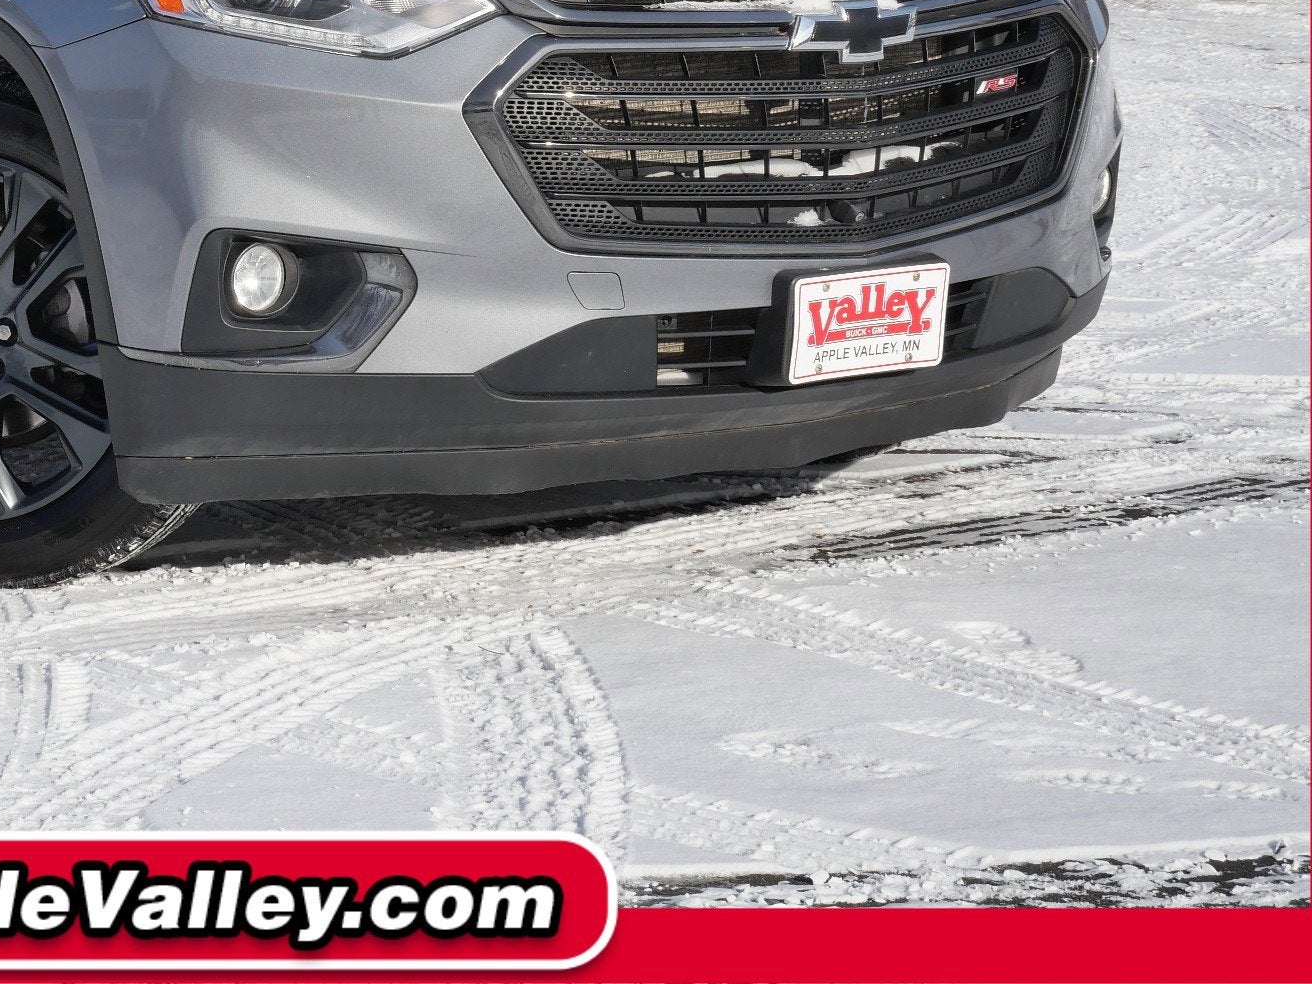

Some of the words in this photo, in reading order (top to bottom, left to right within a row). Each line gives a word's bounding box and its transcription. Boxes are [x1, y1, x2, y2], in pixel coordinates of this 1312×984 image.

[979, 74, 1018, 94] RS
[808, 282, 937, 347] Valley
[845, 327, 867, 338] BUICK
[871, 325, 888, 335] GMC
[813, 347, 850, 364] APPLE
[853, 342, 899, 358] VALLEY,
[902, 339, 921, 352] MN
